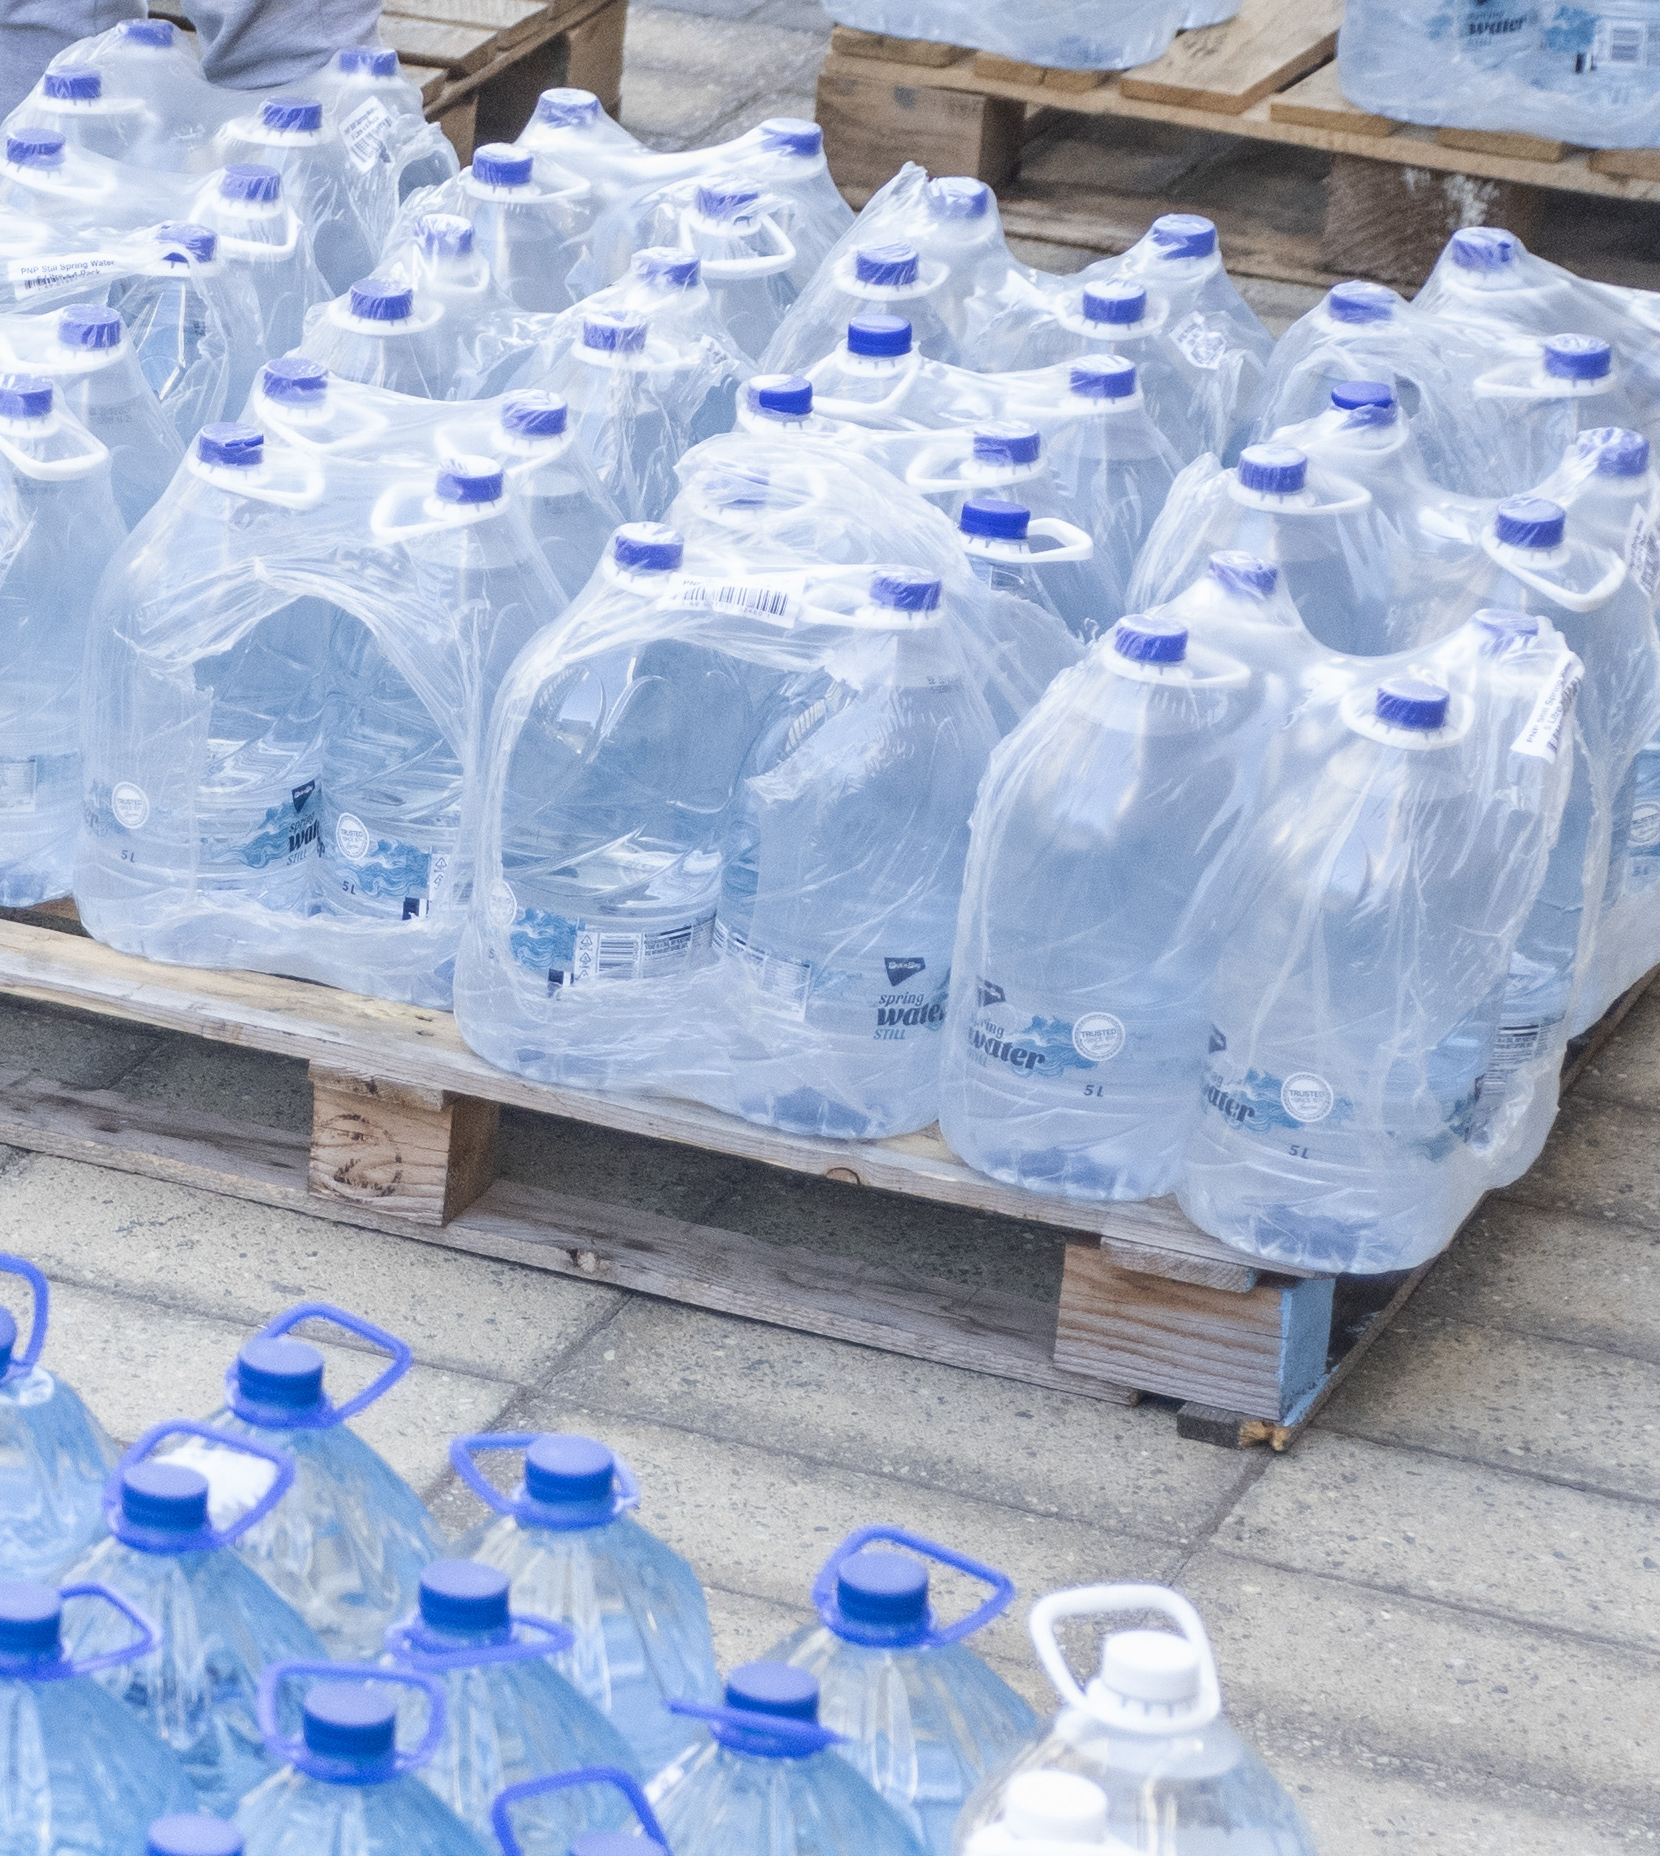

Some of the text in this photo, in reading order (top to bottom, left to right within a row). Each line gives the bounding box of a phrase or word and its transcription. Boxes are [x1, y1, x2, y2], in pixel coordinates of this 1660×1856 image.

[21, 266, 39, 275] PNP
[59, 261, 88, 272] Spring
[90, 259, 116, 268] Water
[121, 848, 137, 864] 5 L
[286, 848, 307, 866] STILL
[342, 880, 358, 896] 5 L
[879, 991, 925, 1007] spring
[873, 1028, 906, 1041] STILL
[1080, 1027, 1118, 1039] TRUSTED
[1083, 1084, 1104, 1098] 5 L
[1289, 1143, 1309, 1160] 5 L
